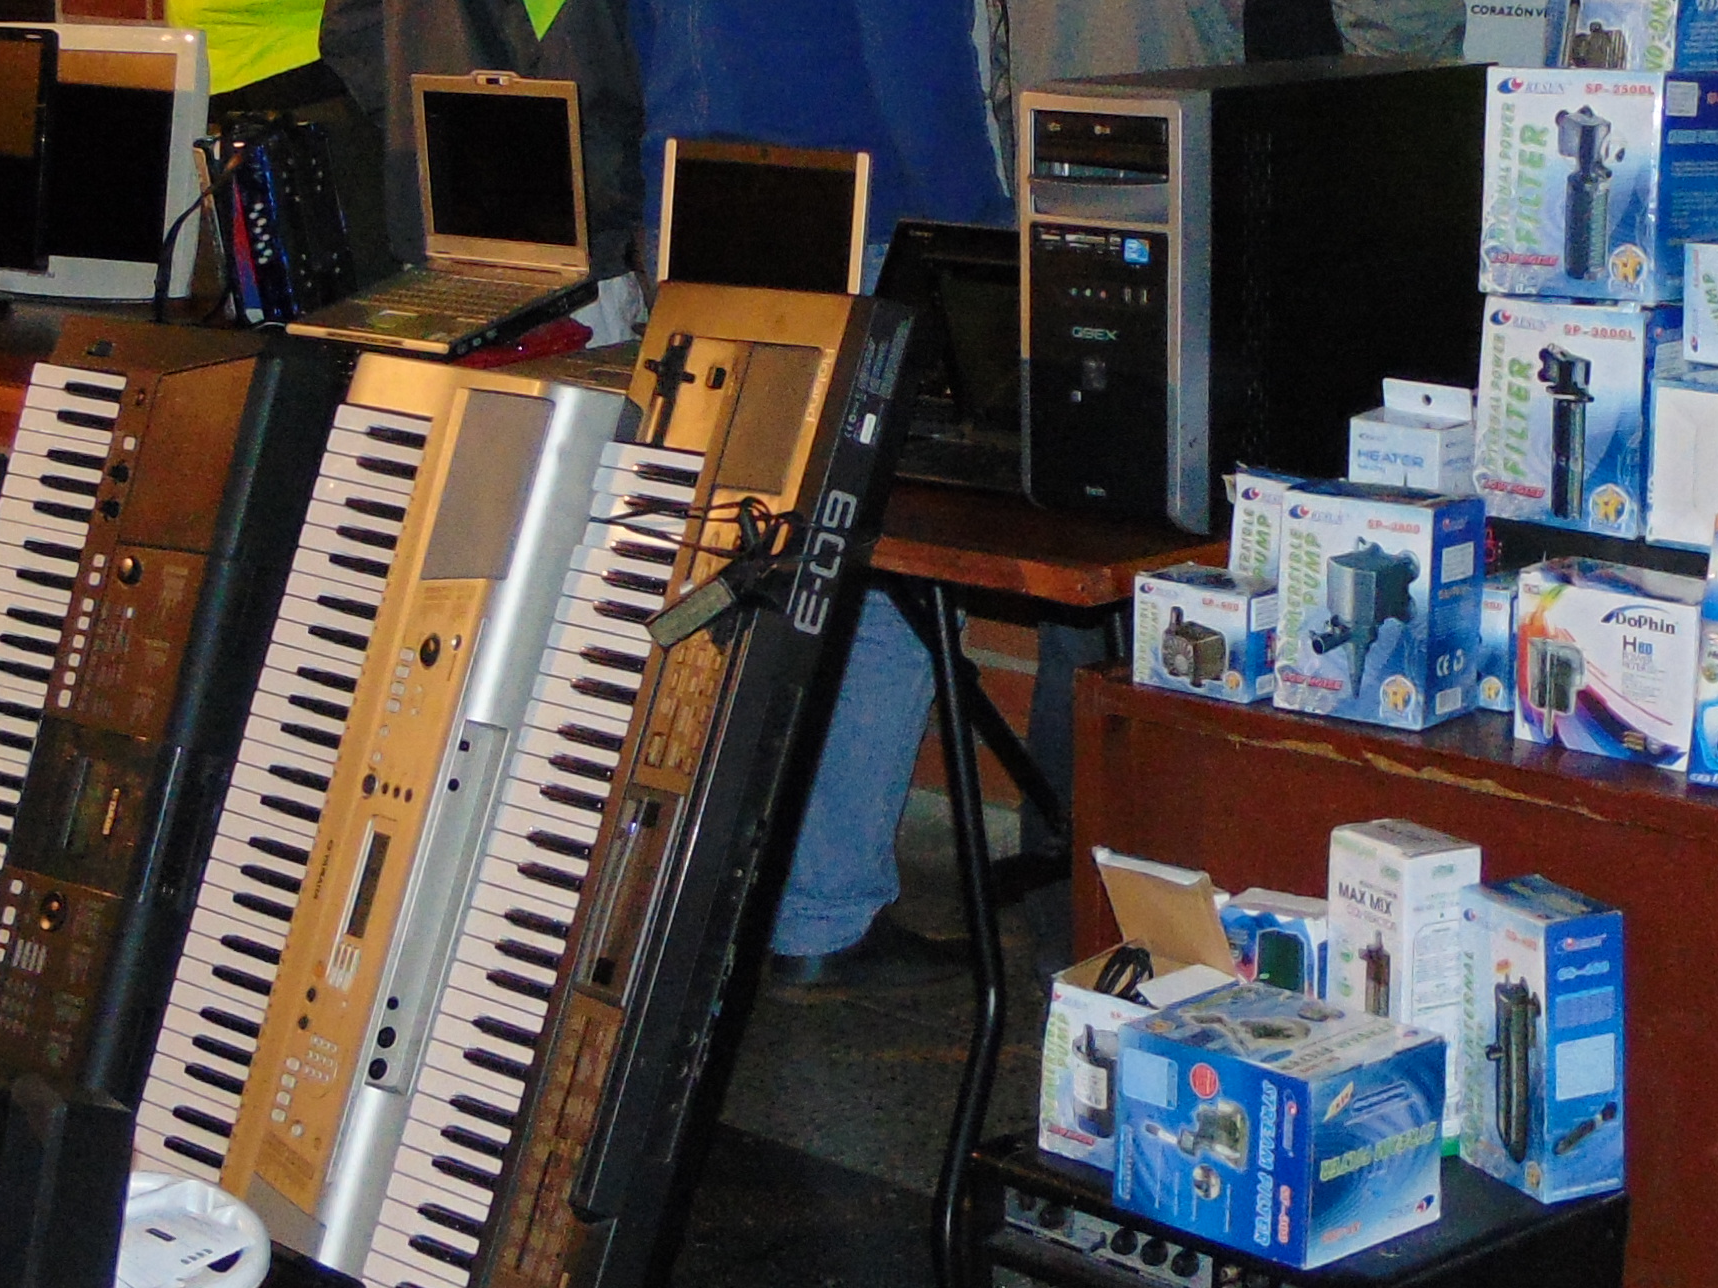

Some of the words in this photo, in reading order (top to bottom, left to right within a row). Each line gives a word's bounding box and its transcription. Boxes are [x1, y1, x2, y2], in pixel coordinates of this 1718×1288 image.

[1515, 123, 1550, 246] FILTER
[1503, 356, 1534, 479] FILTER
[1252, 513, 1273, 580] PUMP
[1302, 531, 1321, 606] PUMP
[1338, 881, 1366, 905] MAX
[1369, 891, 1392, 917] MIX
